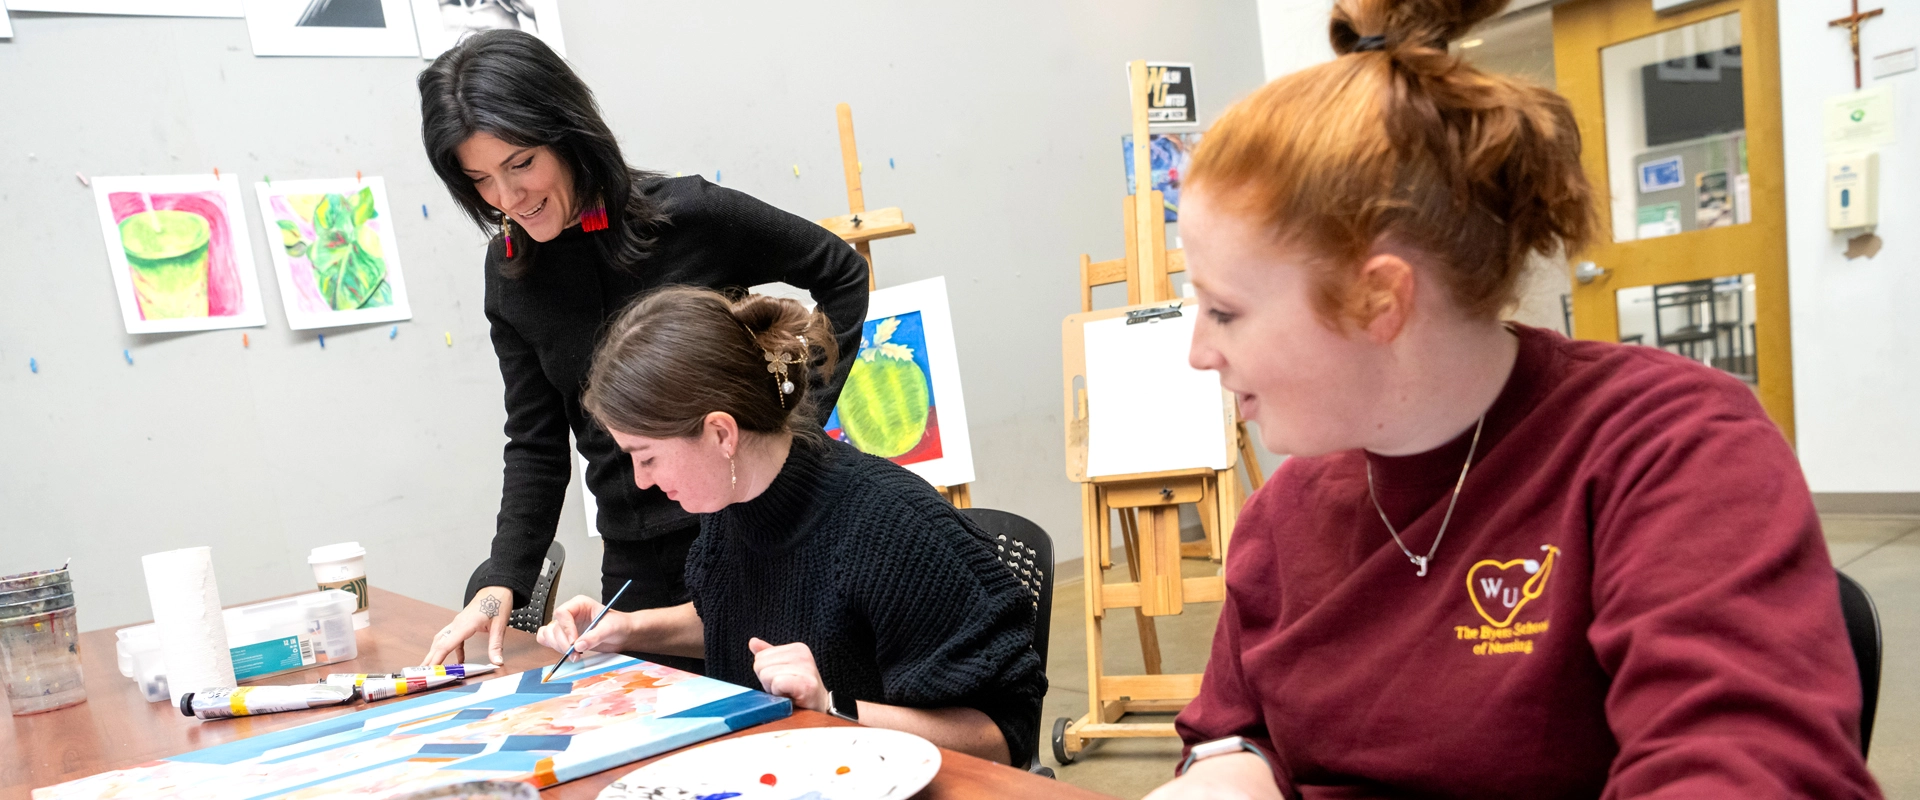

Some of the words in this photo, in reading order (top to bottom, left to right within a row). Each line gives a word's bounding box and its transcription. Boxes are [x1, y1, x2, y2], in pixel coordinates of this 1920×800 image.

[1454, 626, 1479, 639] The
[1473, 641, 1488, 655] of
[1488, 639, 1533, 655] Nursing
